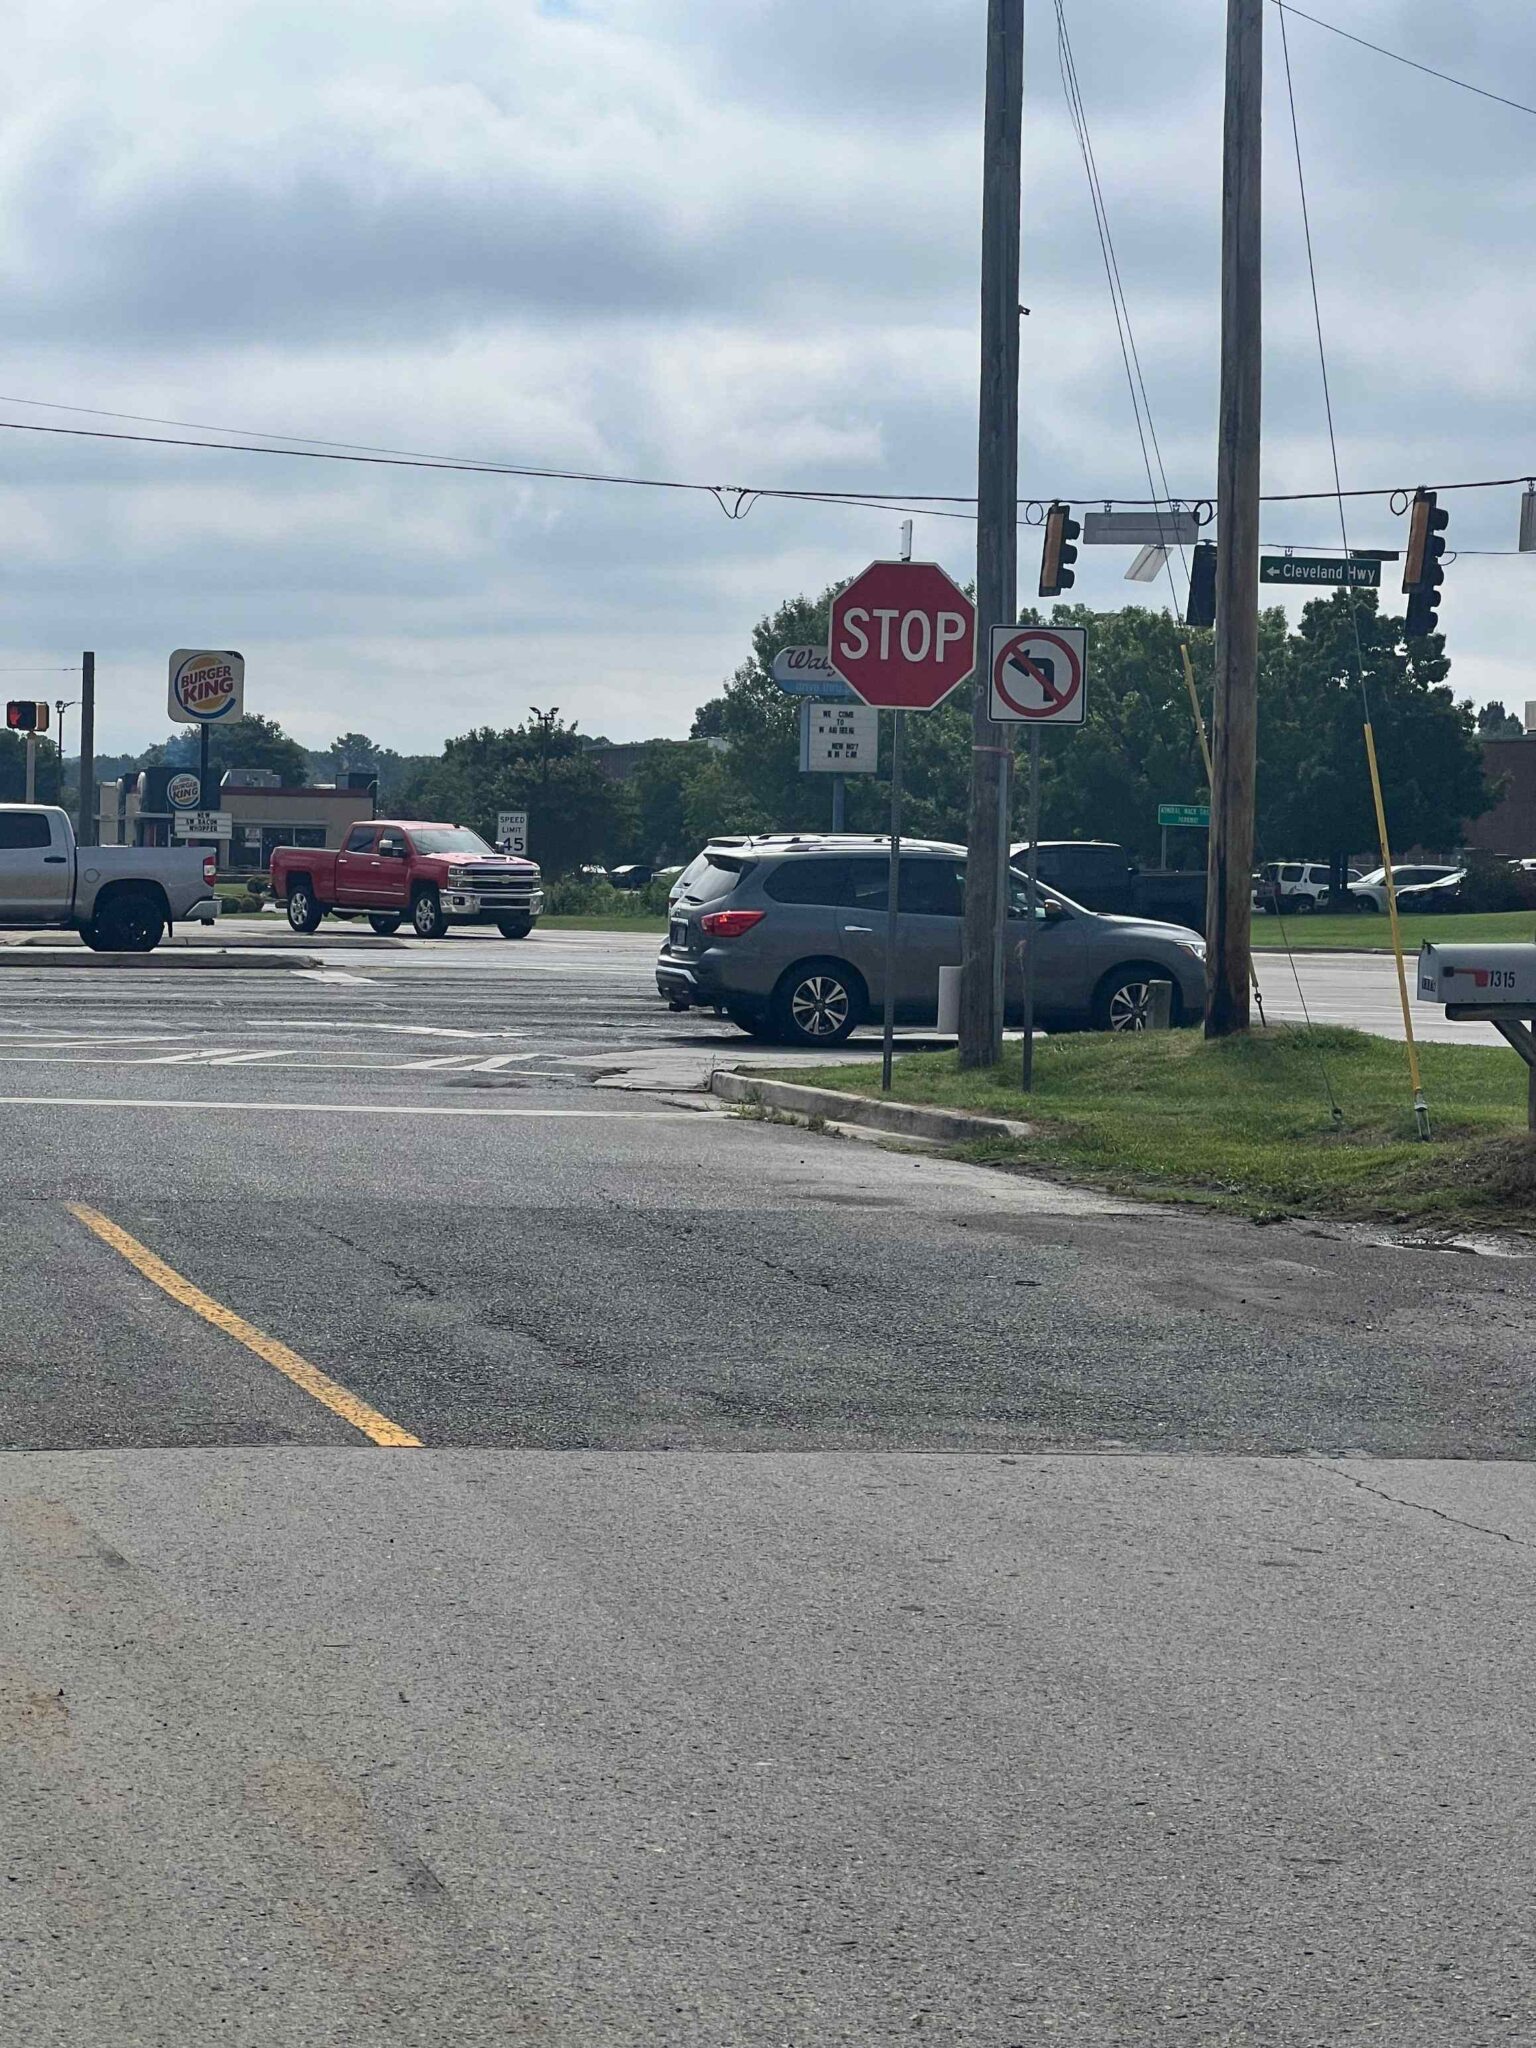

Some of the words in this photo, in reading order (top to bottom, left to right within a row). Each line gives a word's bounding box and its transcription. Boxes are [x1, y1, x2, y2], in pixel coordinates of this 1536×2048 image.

[1283, 563, 1342, 579] Cleveland
[1348, 565, 1375, 583] Hwy
[840, 607, 966, 663] STOP
[181, 665, 231, 688] BURGER
[183, 677, 233, 704] KING
[172, 787, 198, 801] KING
[500, 816, 525, 824] SPEED
[503, 837, 525, 852] 45
[1489, 970, 1516, 988] 1315
